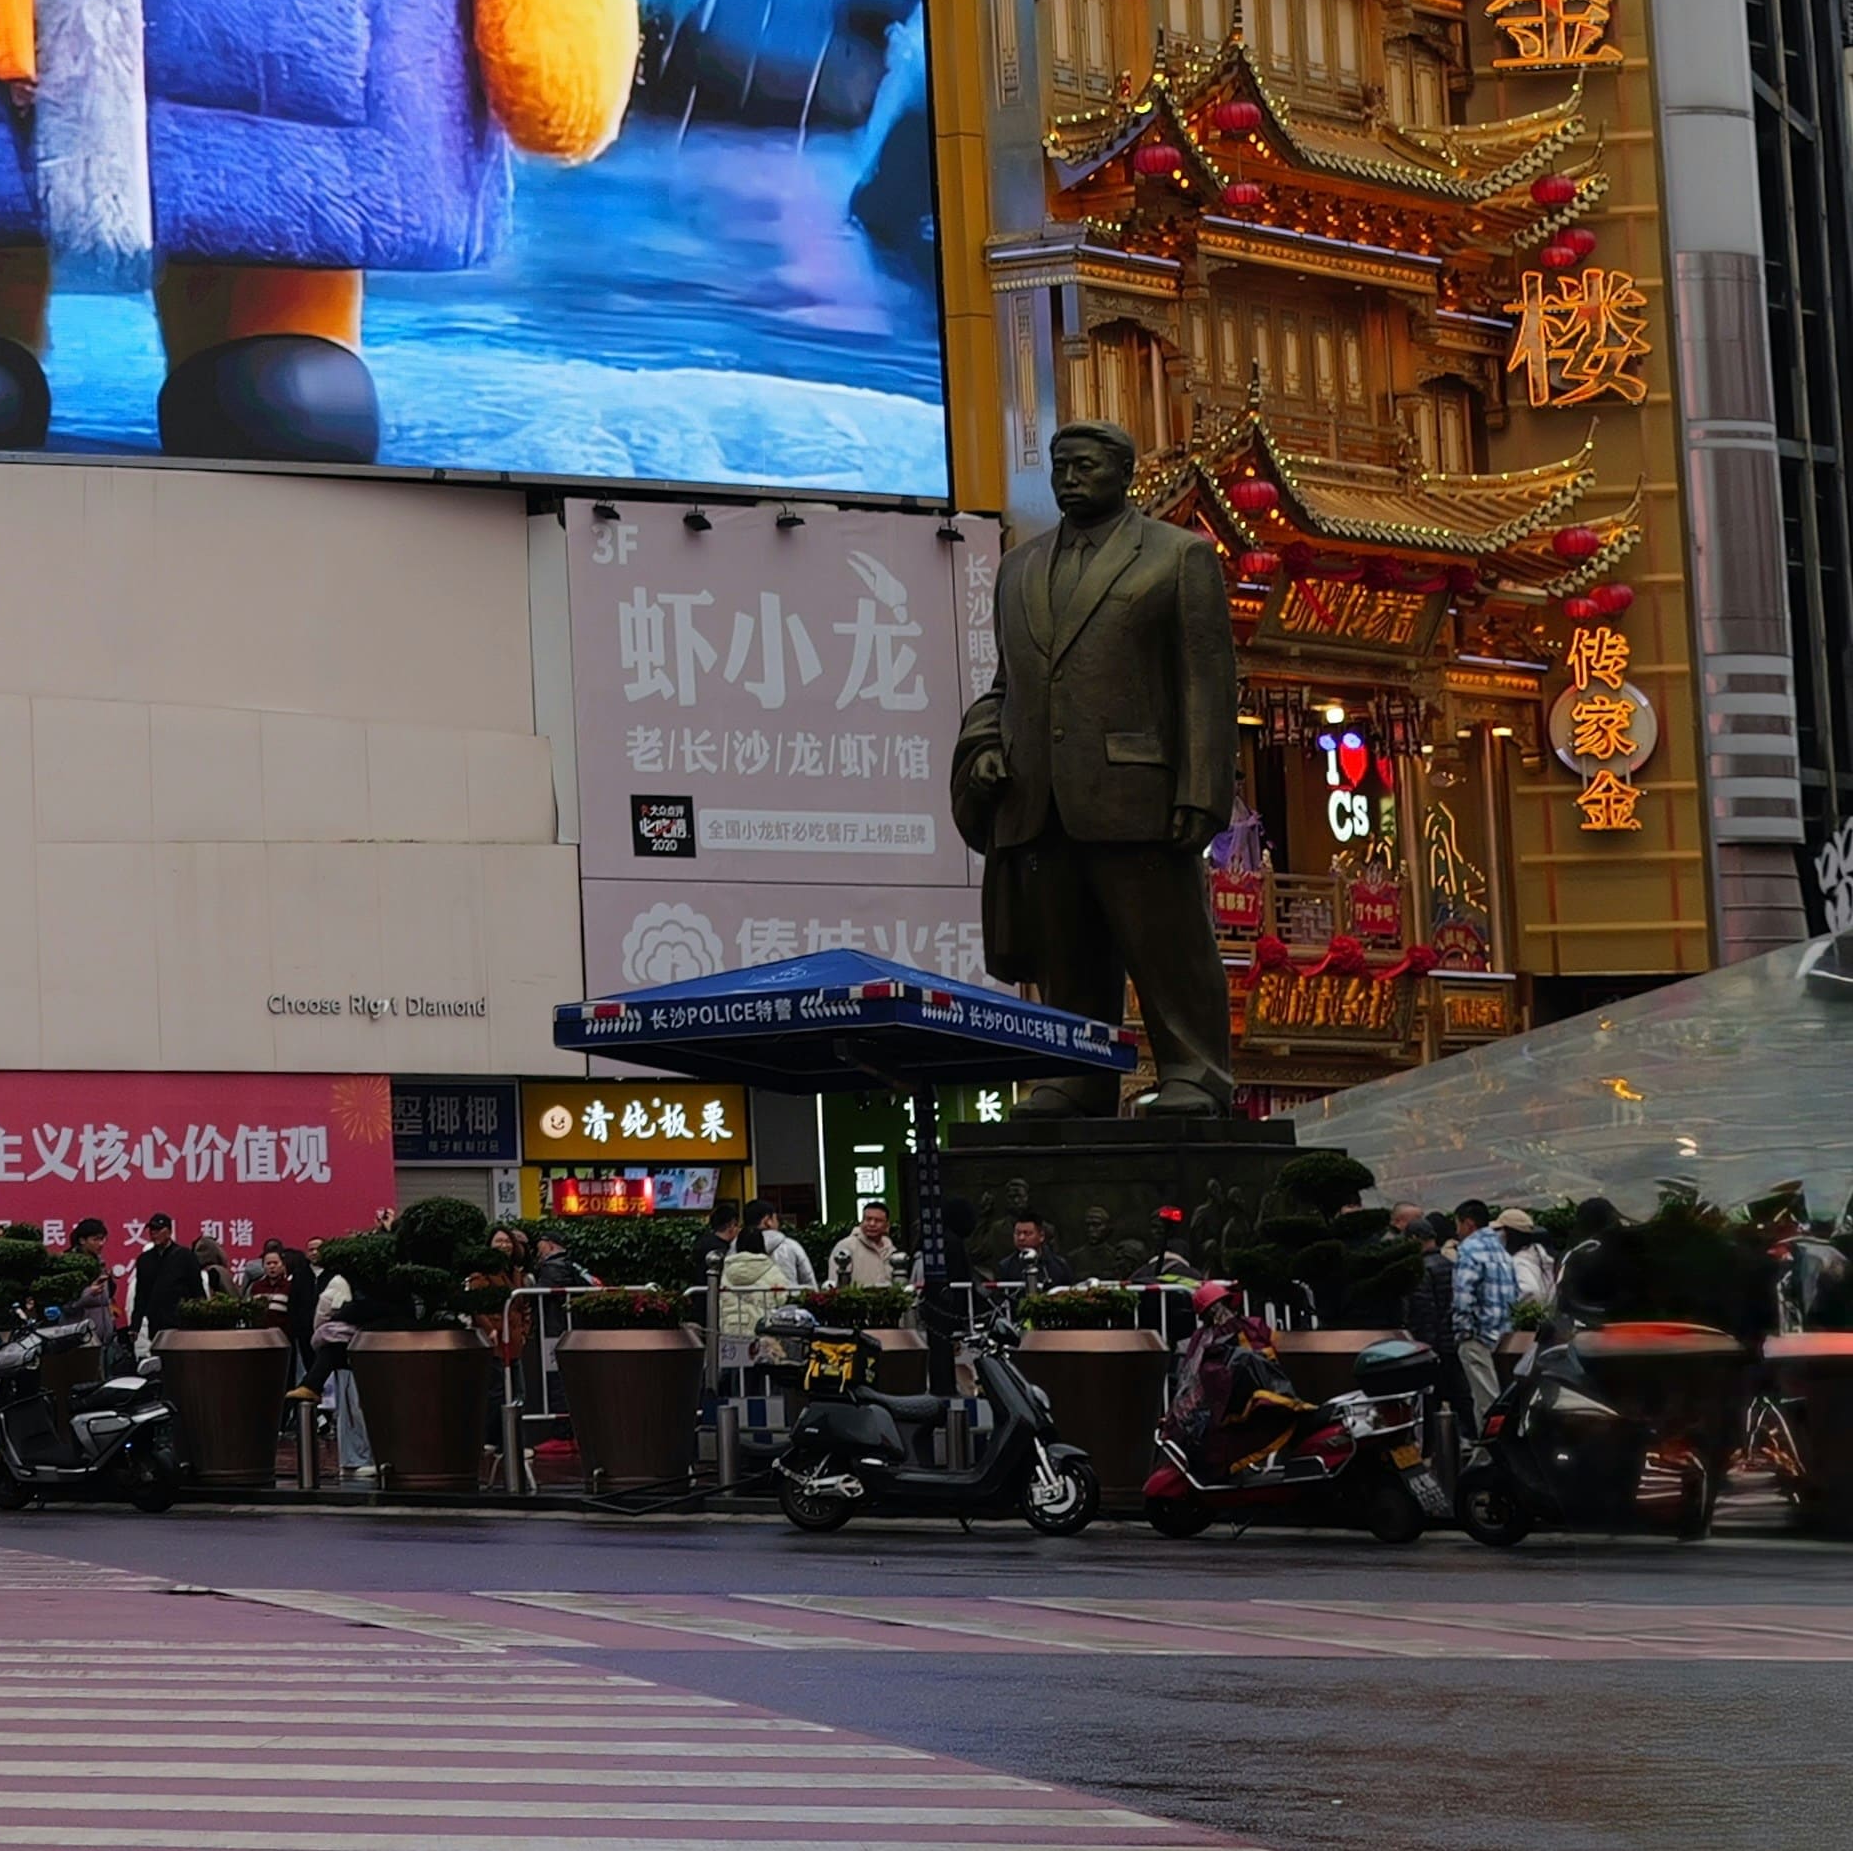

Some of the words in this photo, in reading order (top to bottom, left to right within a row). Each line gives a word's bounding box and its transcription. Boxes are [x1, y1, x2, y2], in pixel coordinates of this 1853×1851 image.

[592, 523, 639, 566] 3F
[618, 550, 930, 712] 虾小龙
[650, 804, 685, 818] 大众点评
[651, 838, 679, 852] 2020
[708, 819, 928, 845] 全国小龙虾必吃餐厅上榜品牌
[266, 994, 342, 1016] Choose
[405, 996, 487, 1018] Diamond
[649, 998, 793, 1031] 长沙POLICE特警
[969, 1003, 1069, 1047] 长沙POLICE特警
[581, 1098, 734, 1144] 清纯板栗
[200, 1218, 254, 1247] 和谐
